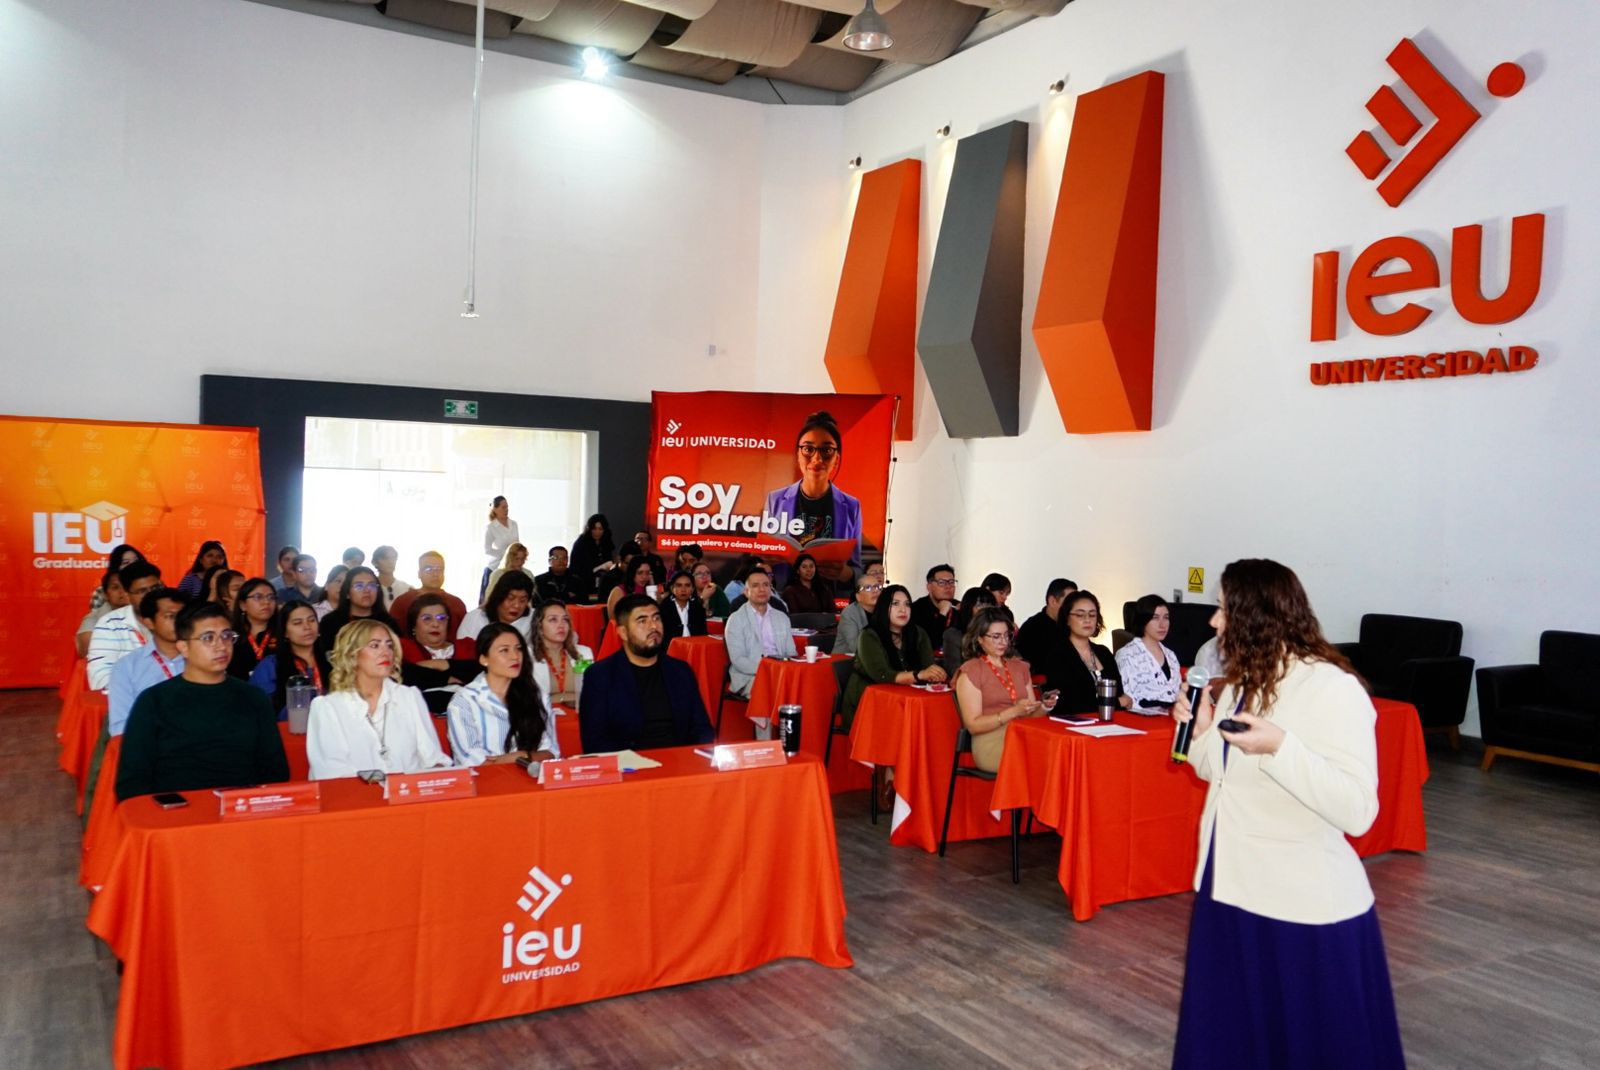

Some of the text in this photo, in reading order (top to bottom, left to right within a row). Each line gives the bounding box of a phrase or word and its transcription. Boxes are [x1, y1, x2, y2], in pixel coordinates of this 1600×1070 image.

[1310, 346, 1539, 385] UNIVERSIDAD
[690, 436, 776, 449] UNIVERSIDAD
[659, 476, 740, 515] Soy
[657, 506, 805, 535] imparable
[33, 512, 125, 555] IEU
[697, 539, 722, 547] quiero
[730, 541, 753, 549] cómo
[753, 542, 786, 551] lograrlo
[33, 557, 109, 569] Graduaci
[502, 962, 581, 984] UNIVERSIDAD
